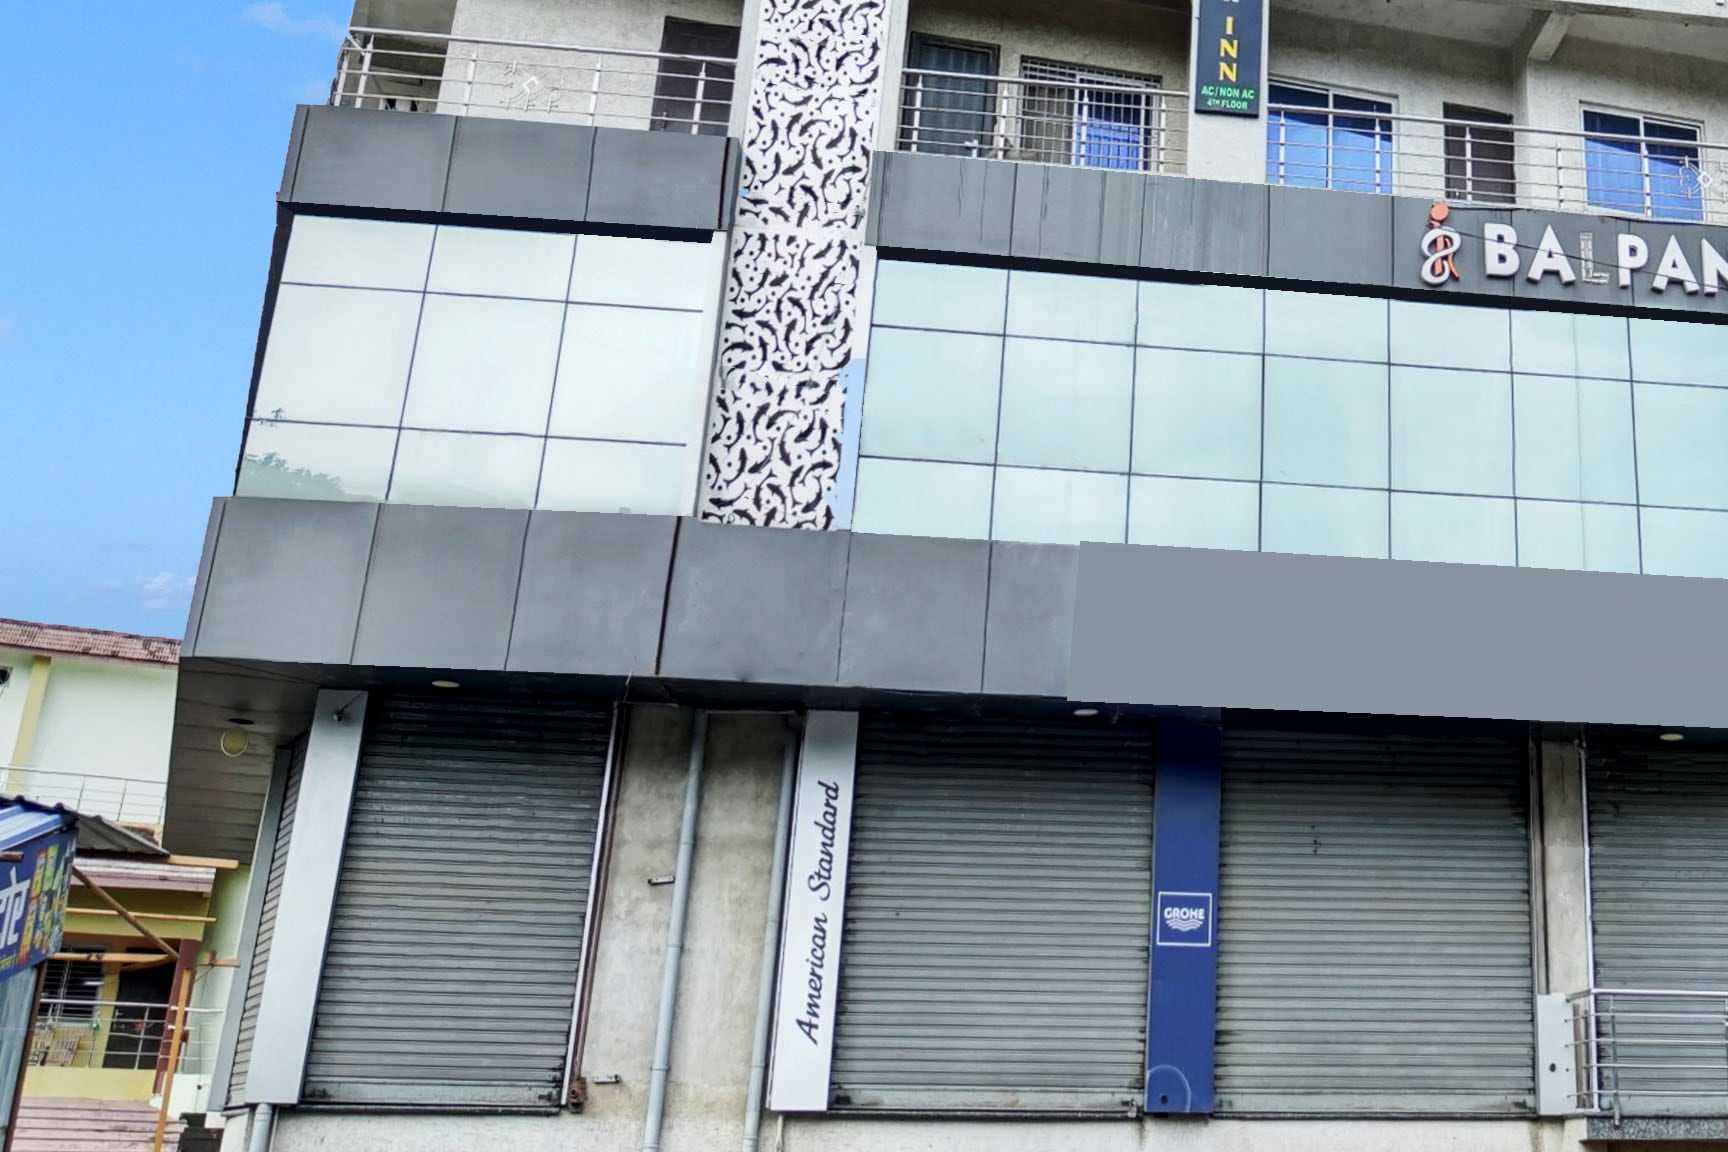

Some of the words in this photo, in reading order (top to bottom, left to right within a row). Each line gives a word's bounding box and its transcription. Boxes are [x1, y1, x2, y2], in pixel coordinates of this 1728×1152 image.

[1218, 16, 1239, 83] INN
[1221, 99, 1248, 110] FLOOR
[807, 780, 840, 902] Standard
[1163, 907, 1206, 920] GROHE
[795, 912, 829, 1046] American
